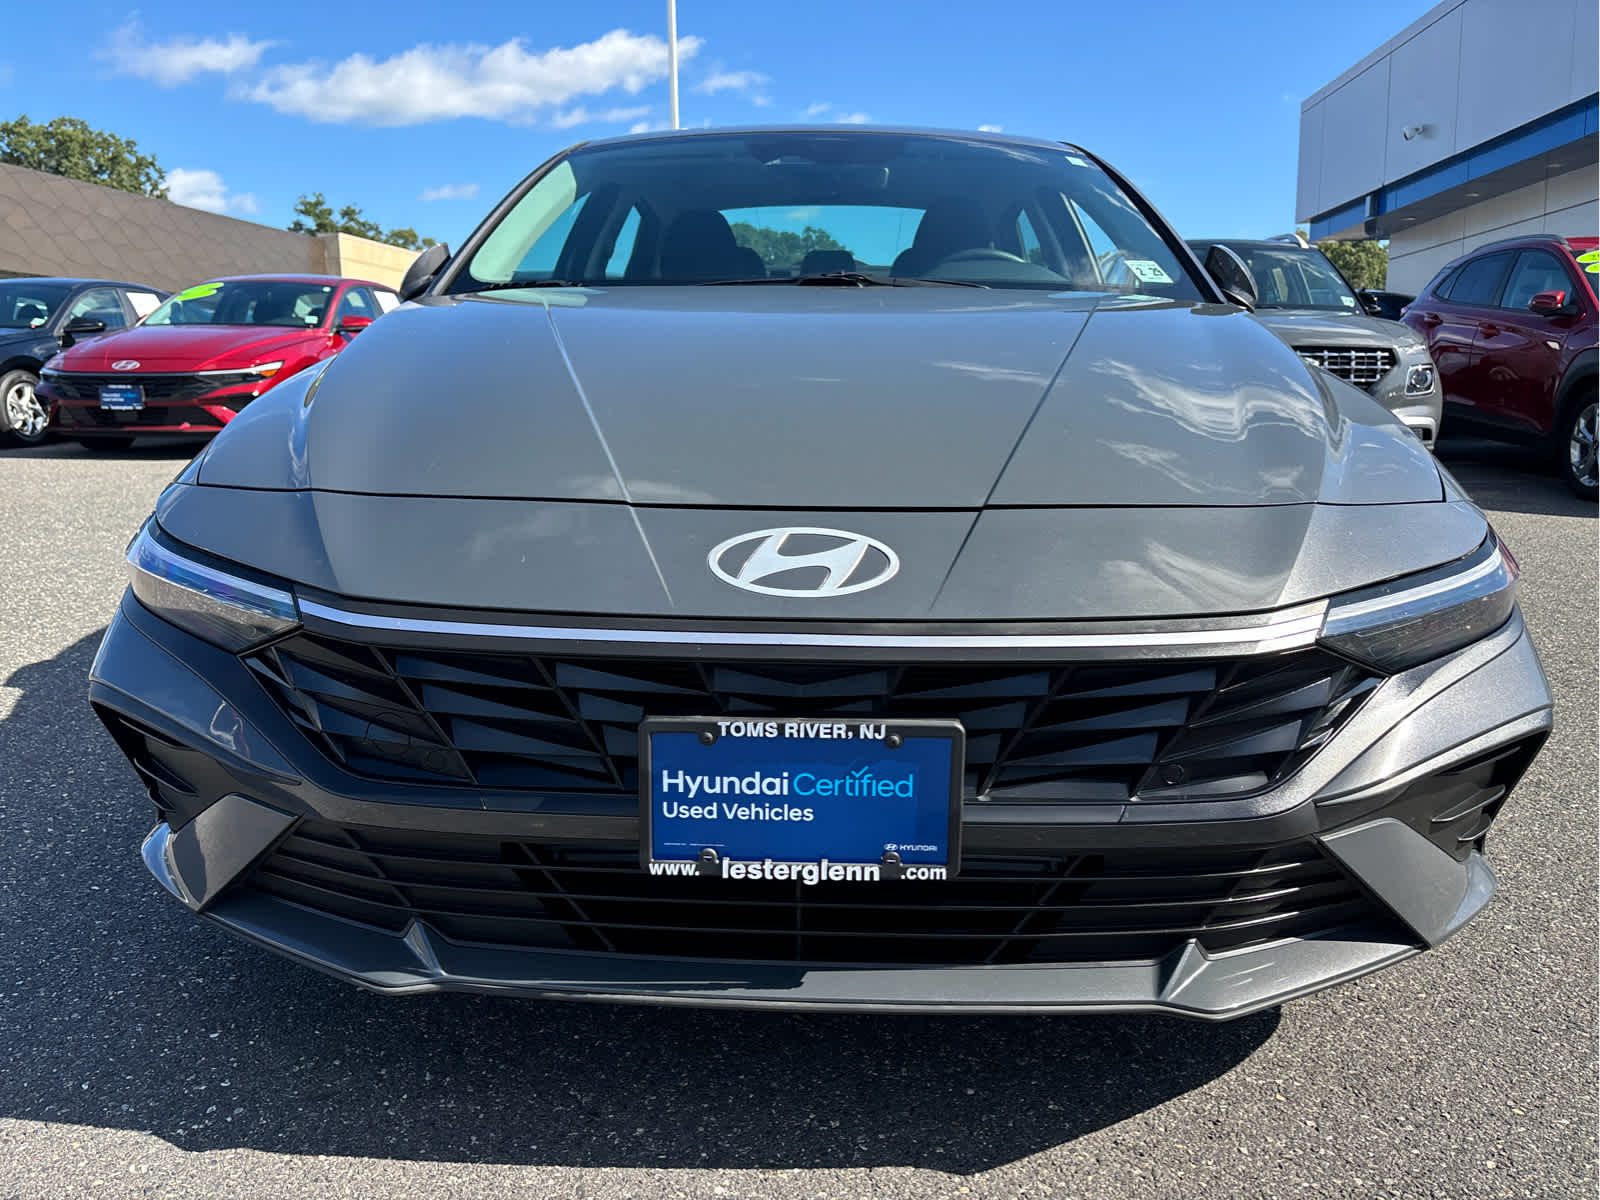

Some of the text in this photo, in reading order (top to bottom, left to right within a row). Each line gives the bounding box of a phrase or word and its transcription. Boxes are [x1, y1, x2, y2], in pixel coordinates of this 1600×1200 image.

[718, 721, 886, 740] TOMS RIVER, NJ
[662, 767, 914, 798] Hyundai Certified
[662, 801, 815, 821] Used Vehicles
[649, 857, 947, 885] www. lesterglenn .com
